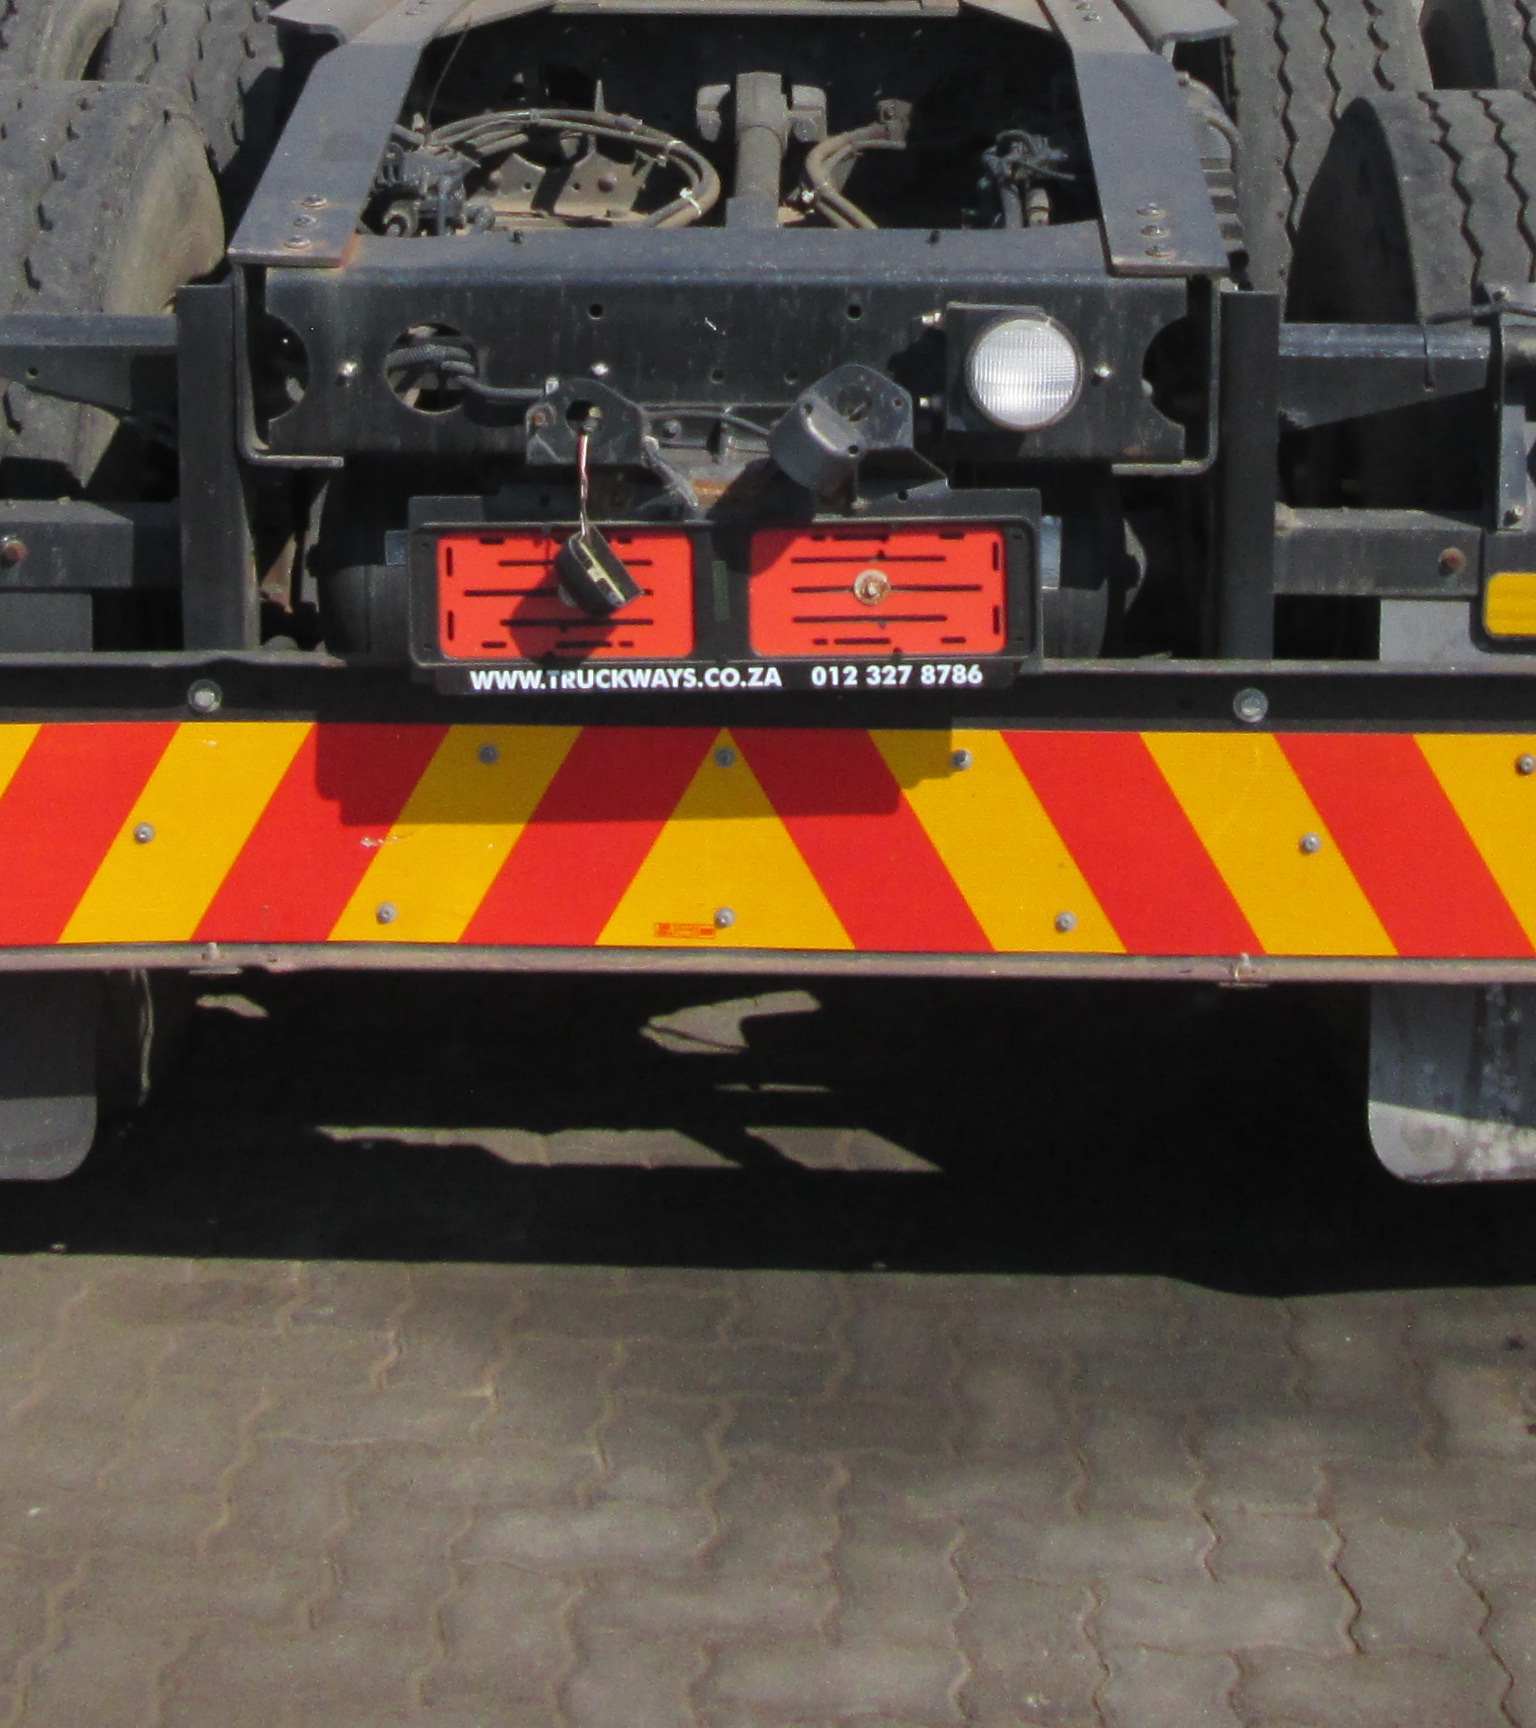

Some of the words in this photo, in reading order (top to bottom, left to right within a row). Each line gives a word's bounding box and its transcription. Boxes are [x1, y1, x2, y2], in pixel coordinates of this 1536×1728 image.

[469, 666, 782, 690] WWW.TRUCKWAYS.CO.ZA
[811, 666, 858, 686] 012
[865, 665, 913, 686] 327
[920, 664, 984, 685] 8786
